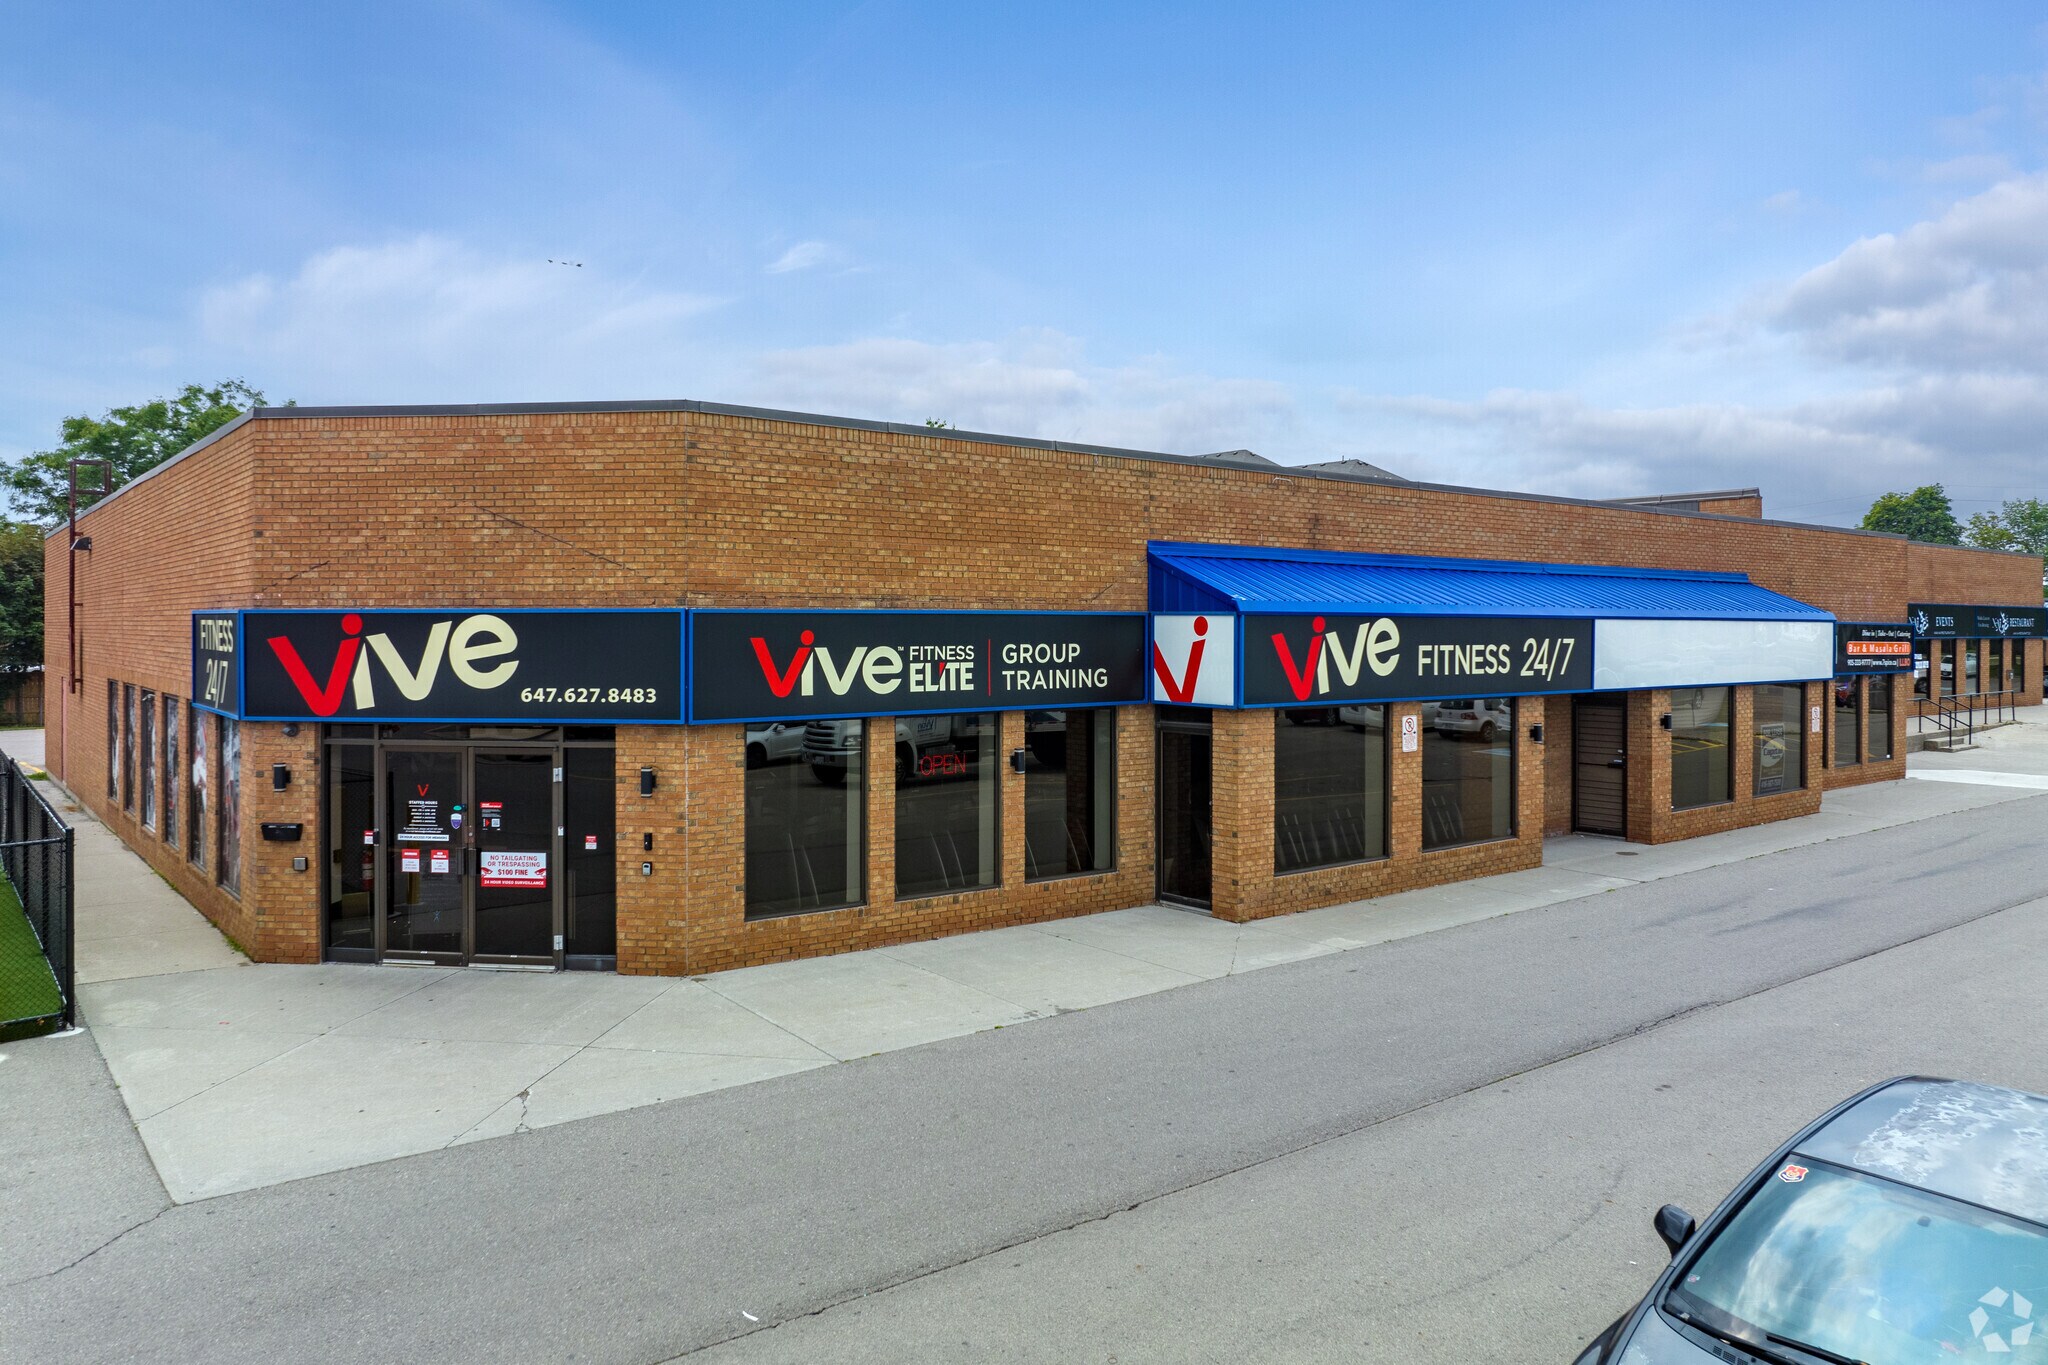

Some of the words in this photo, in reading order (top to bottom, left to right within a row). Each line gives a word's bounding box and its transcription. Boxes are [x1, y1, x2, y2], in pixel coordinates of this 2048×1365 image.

[1935, 616, 1954, 627] EVENTS
[2009, 617, 2035, 627] RESTAURANT
[200, 619, 234, 653] FITNESS
[910, 645, 975, 661] FITNESS
[1002, 643, 1081, 664] GROUP
[1848, 643, 1860, 653] Bar
[1862, 643, 1867, 653] &
[1869, 643, 1892, 653] Masala
[1893, 644, 1910, 653] Grill
[1417, 644, 1511, 676] FITNESS
[1520, 637, 1575, 682] 24/7
[205, 658, 228, 709] 24/7
[910, 662, 974, 692] ELITE
[1002, 668, 1108, 691] TRAINING
[520, 687, 657, 704] 647.627.8483
[920, 753, 966, 776] OPEN
